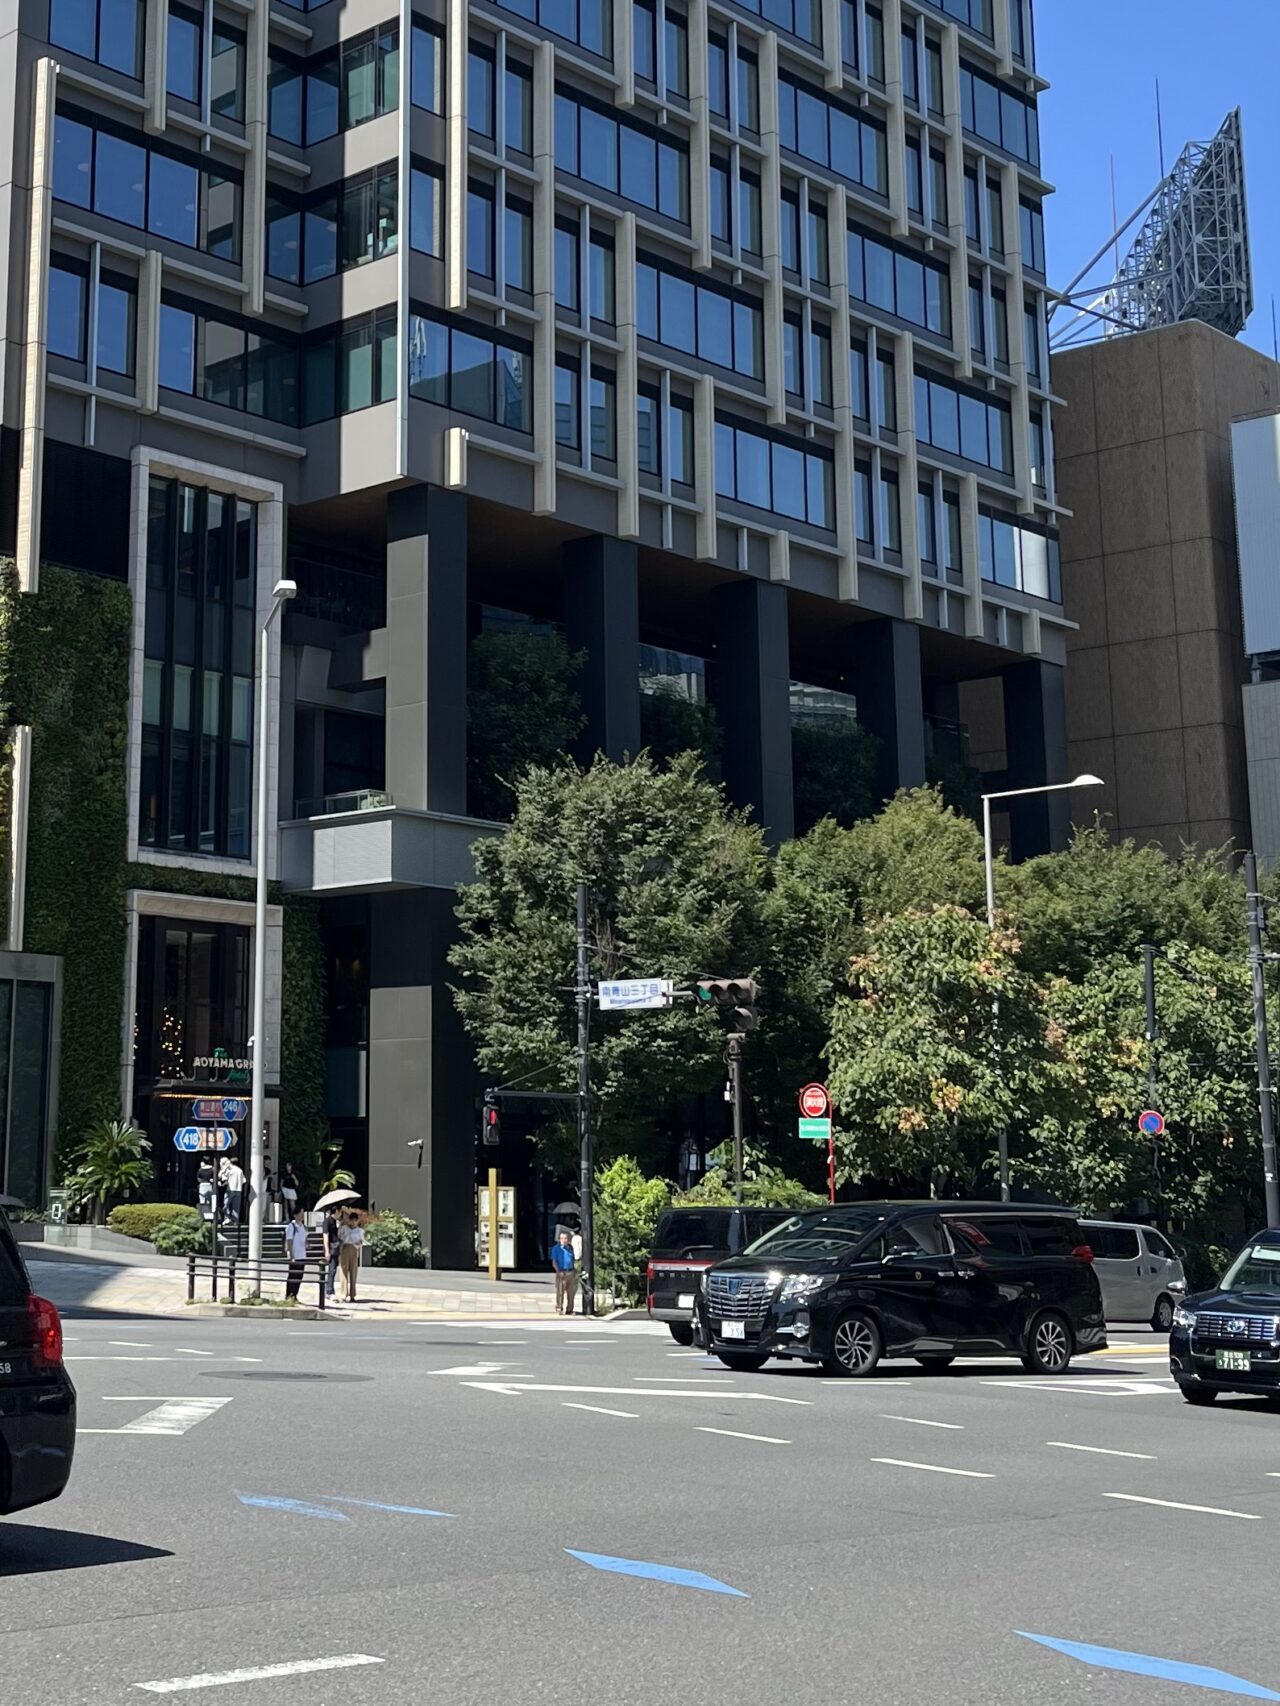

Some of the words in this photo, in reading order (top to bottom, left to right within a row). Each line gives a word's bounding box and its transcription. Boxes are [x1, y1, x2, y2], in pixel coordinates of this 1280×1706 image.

[602, 983, 658, 998] 南青山三丁目
[192, 1056, 234, 1069] AOYAMA
[223, 1100, 238, 1112] 246
[182, 1132, 199, 1146] 418
[1223, 1357, 1250, 1370] 71-99
